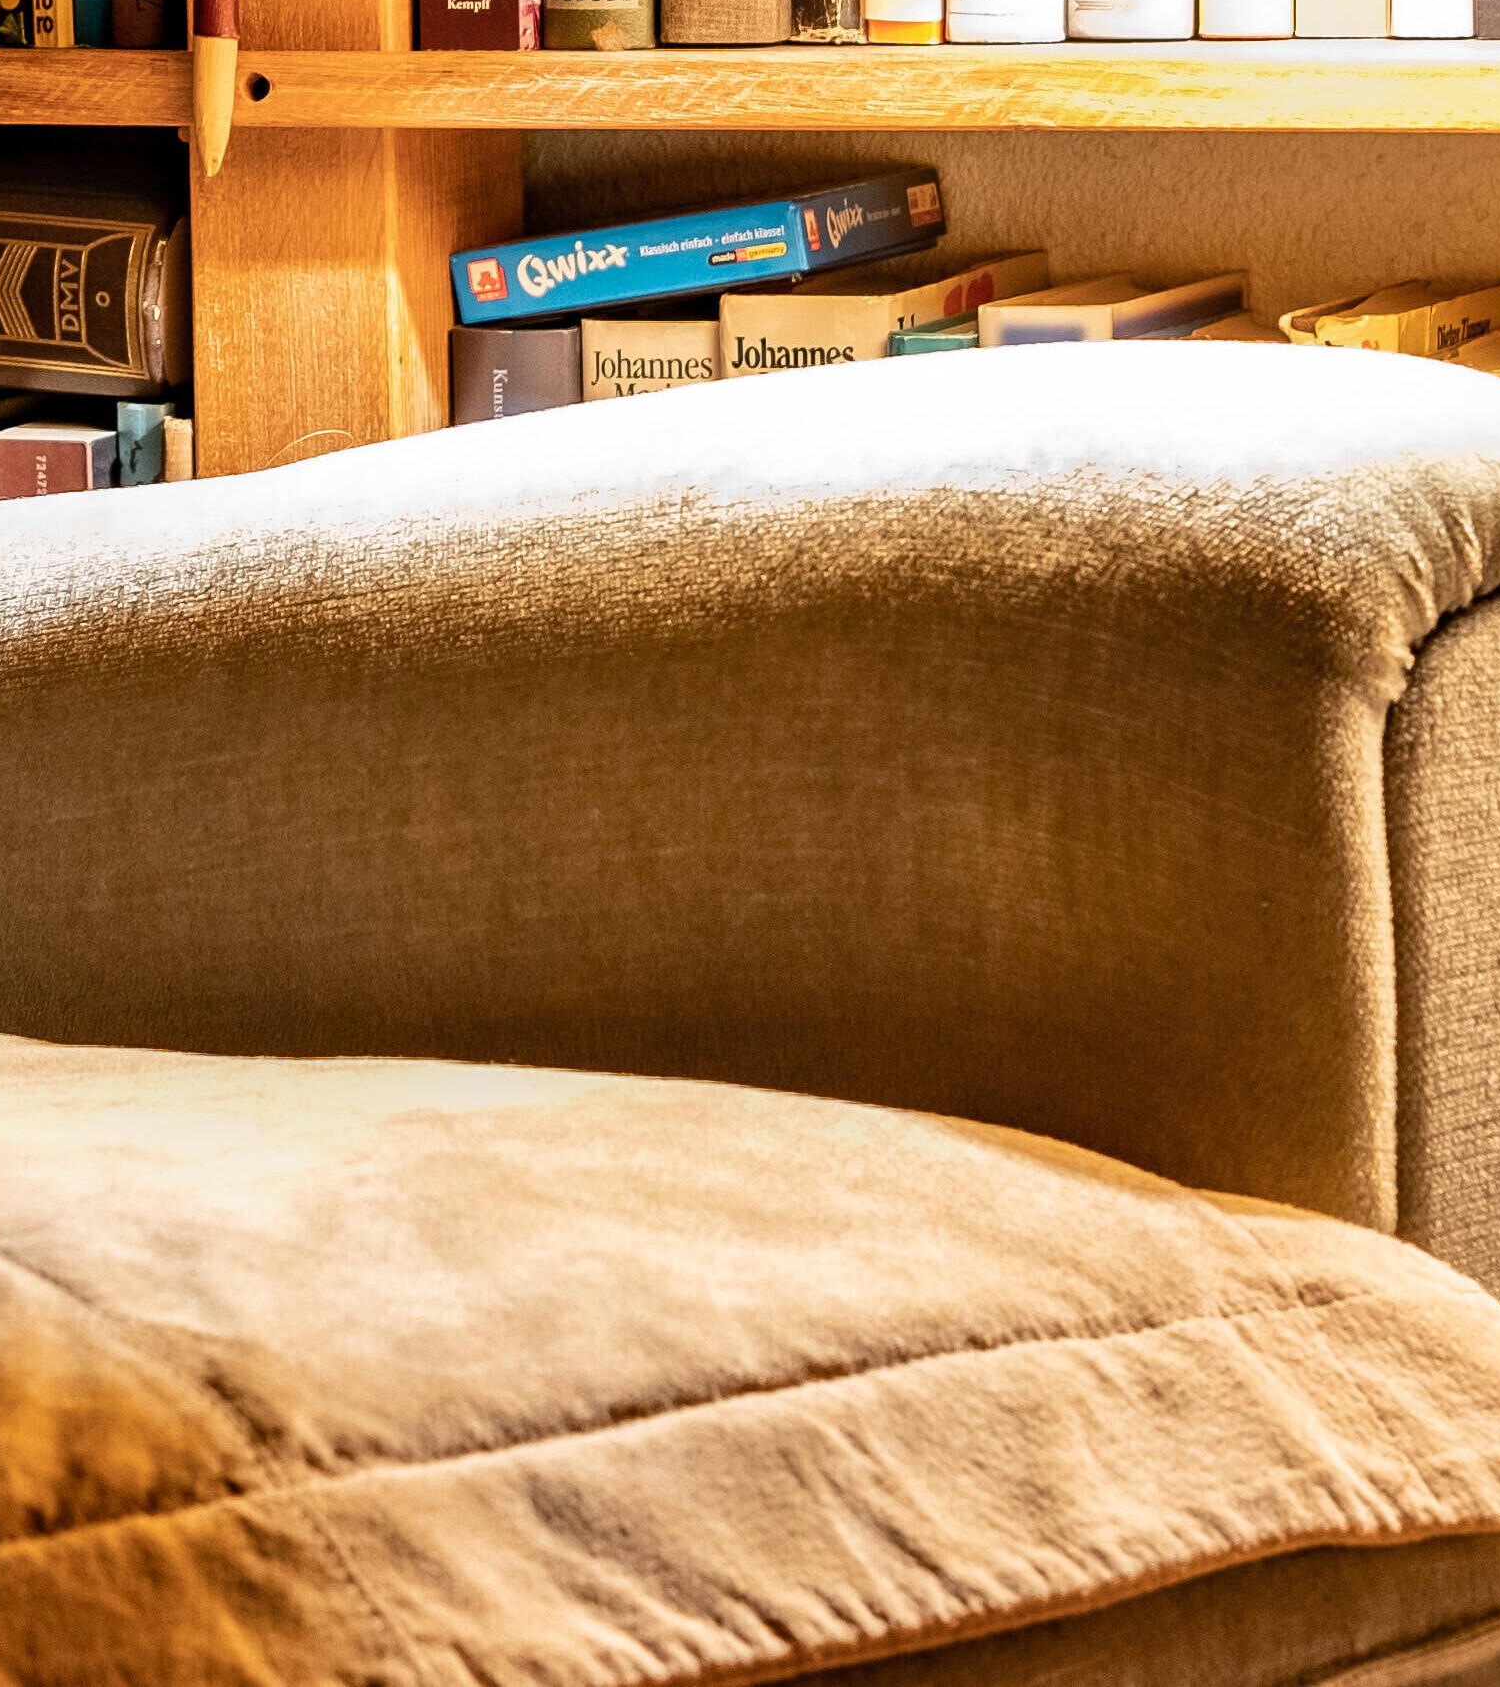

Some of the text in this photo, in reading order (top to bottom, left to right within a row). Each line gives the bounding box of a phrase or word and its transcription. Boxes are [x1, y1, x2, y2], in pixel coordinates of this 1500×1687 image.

[639, 225, 785, 258] Klassisch einfach einfach klasse!
[825, 199, 865, 250] Qwixx
[516, 240, 628, 298] Qwixx
[59, 257, 81, 333] DMV
[590, 349, 713, 386] Johannes
[730, 335, 856, 370] Johannes
